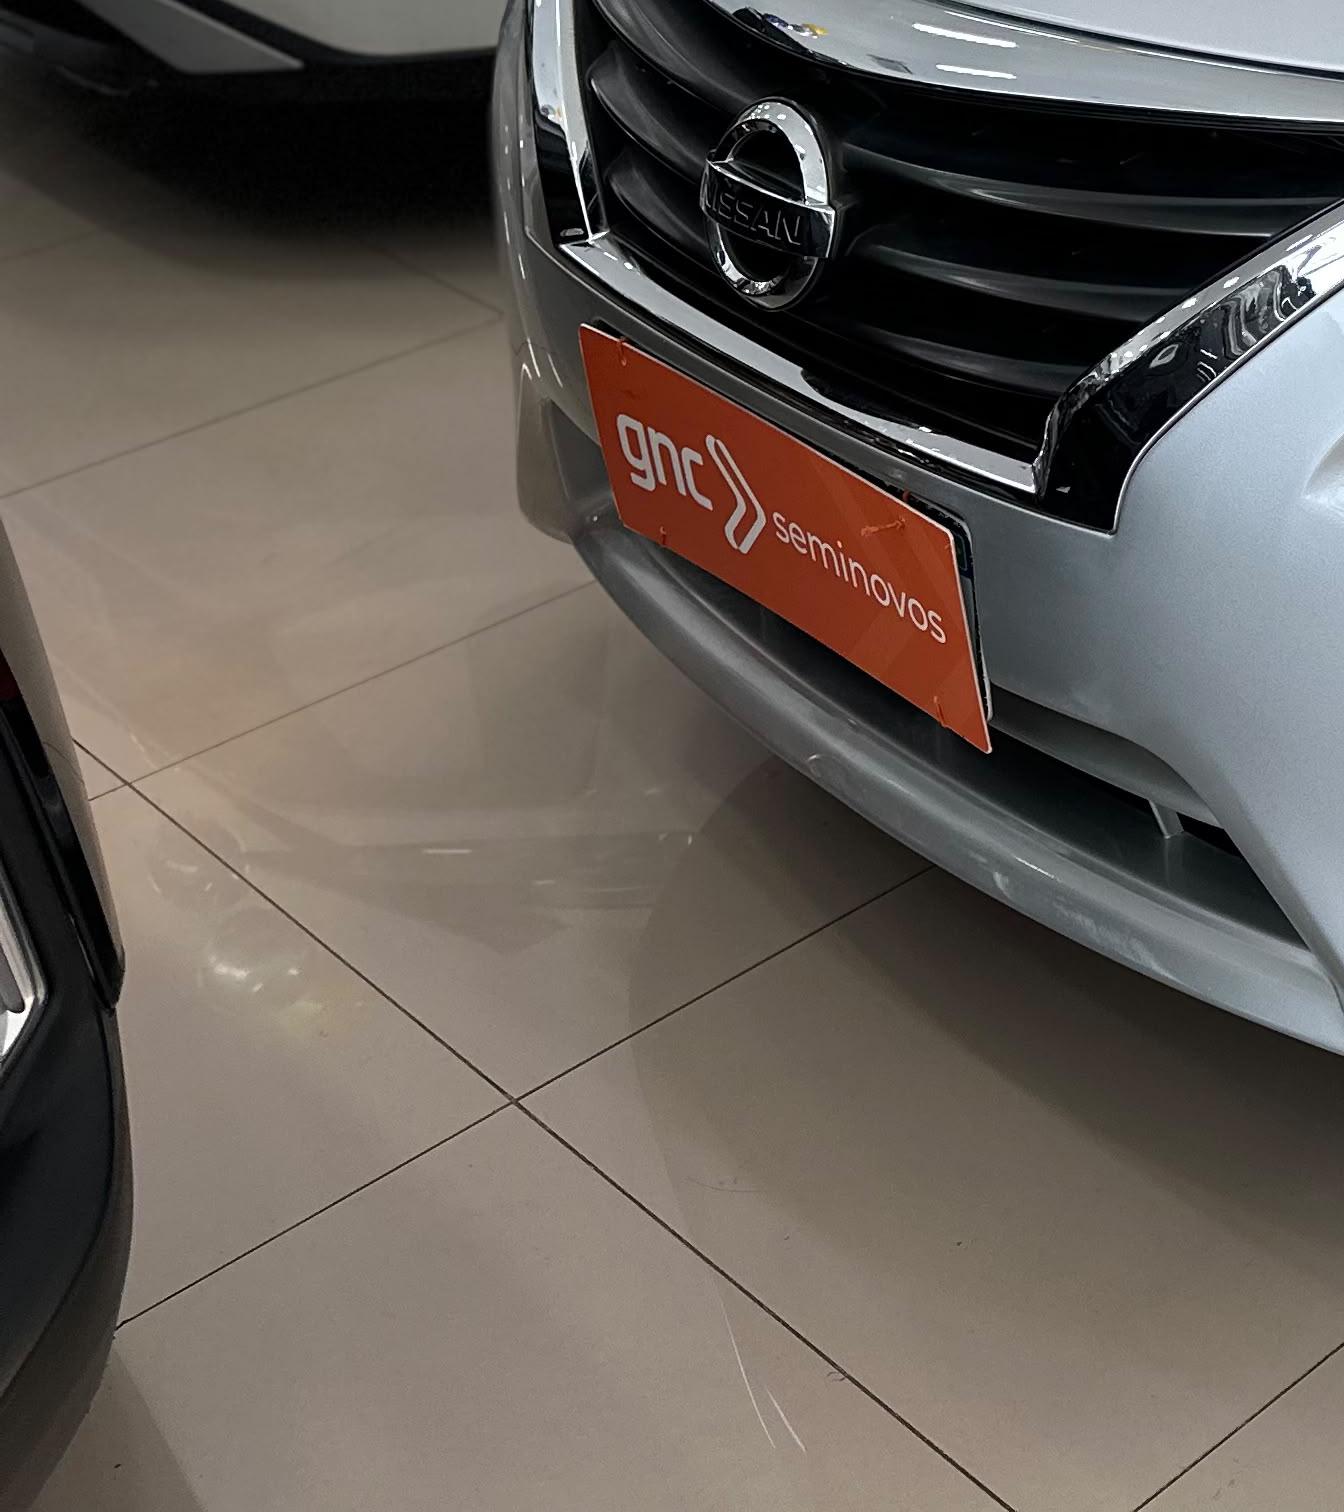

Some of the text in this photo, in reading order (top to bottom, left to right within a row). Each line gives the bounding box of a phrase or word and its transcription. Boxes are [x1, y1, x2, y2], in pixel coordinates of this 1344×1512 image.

[703, 181, 801, 245] NISSAN
[616, 413, 947, 644] gnc seminovos
